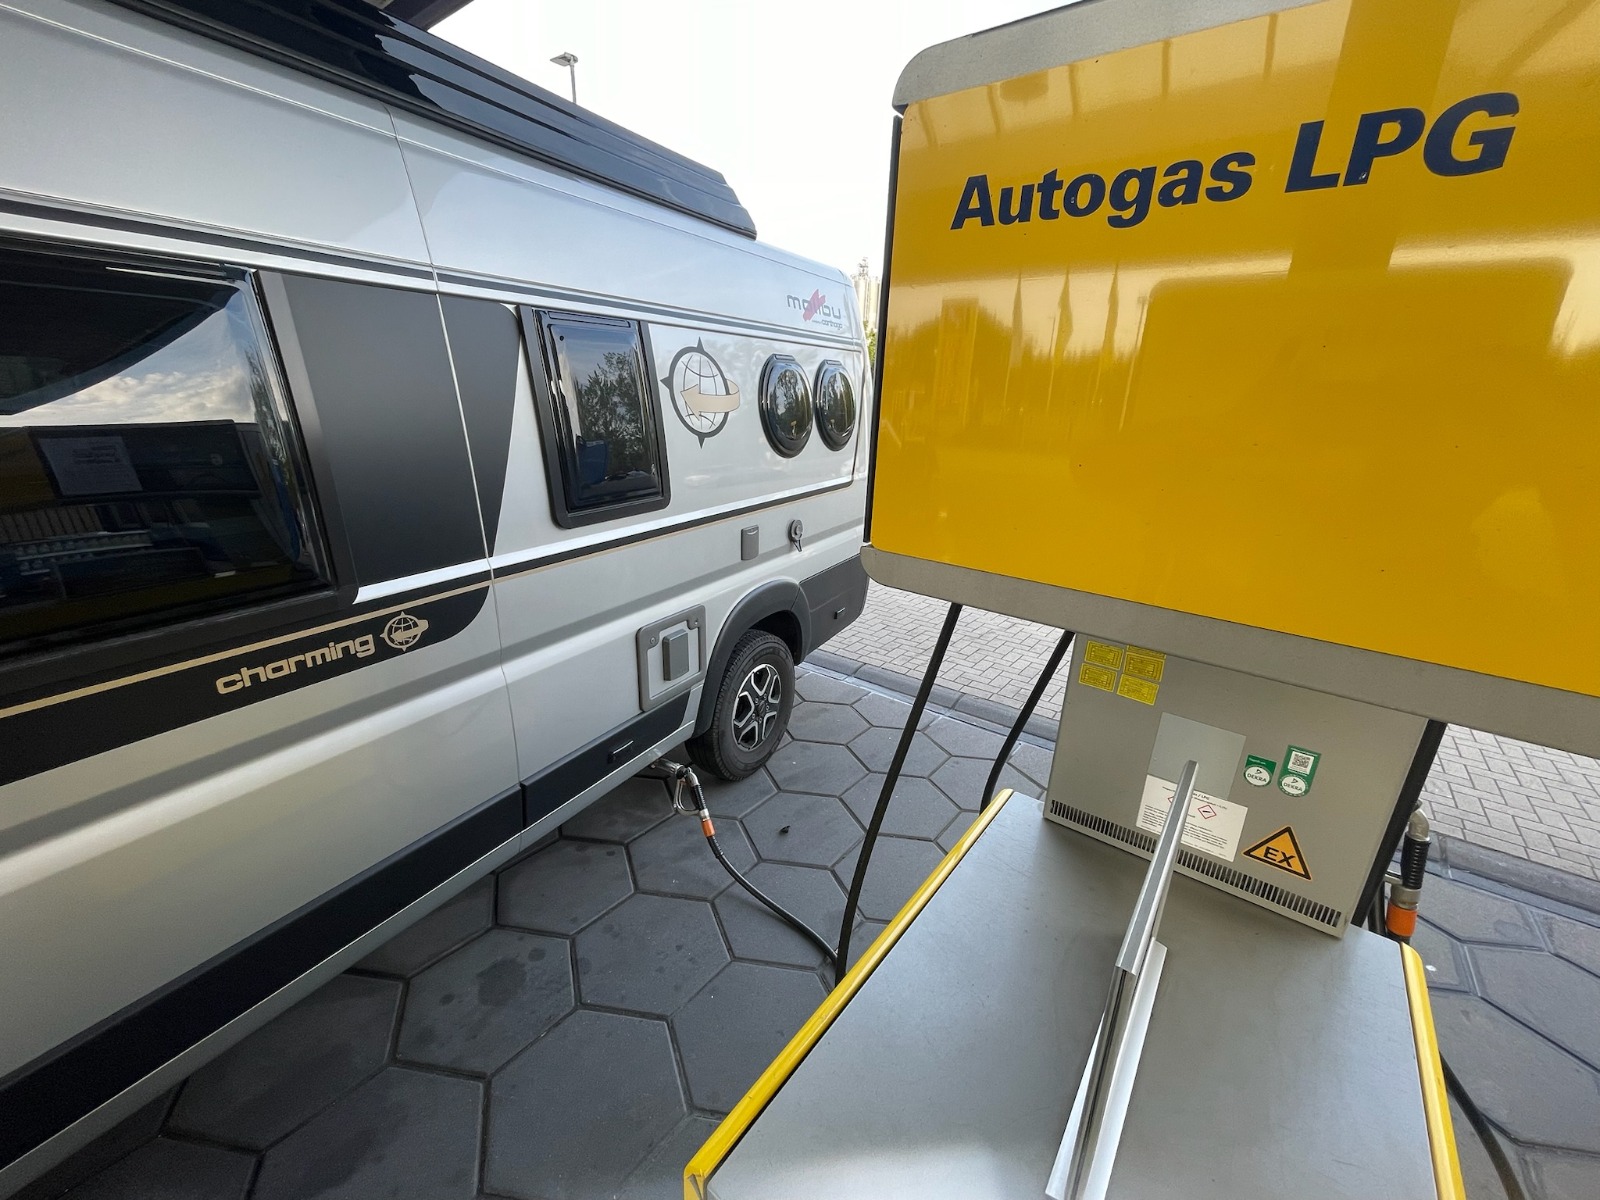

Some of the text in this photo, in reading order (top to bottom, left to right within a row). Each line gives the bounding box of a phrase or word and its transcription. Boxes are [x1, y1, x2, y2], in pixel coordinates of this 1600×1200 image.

[950, 92, 1520, 230] Autogas LPG
[216, 634, 376, 694] charming
[1247, 772, 1267, 782] DEKRA
[1283, 782, 1303, 792] DEKRA
[1263, 846, 1296, 868] EX
